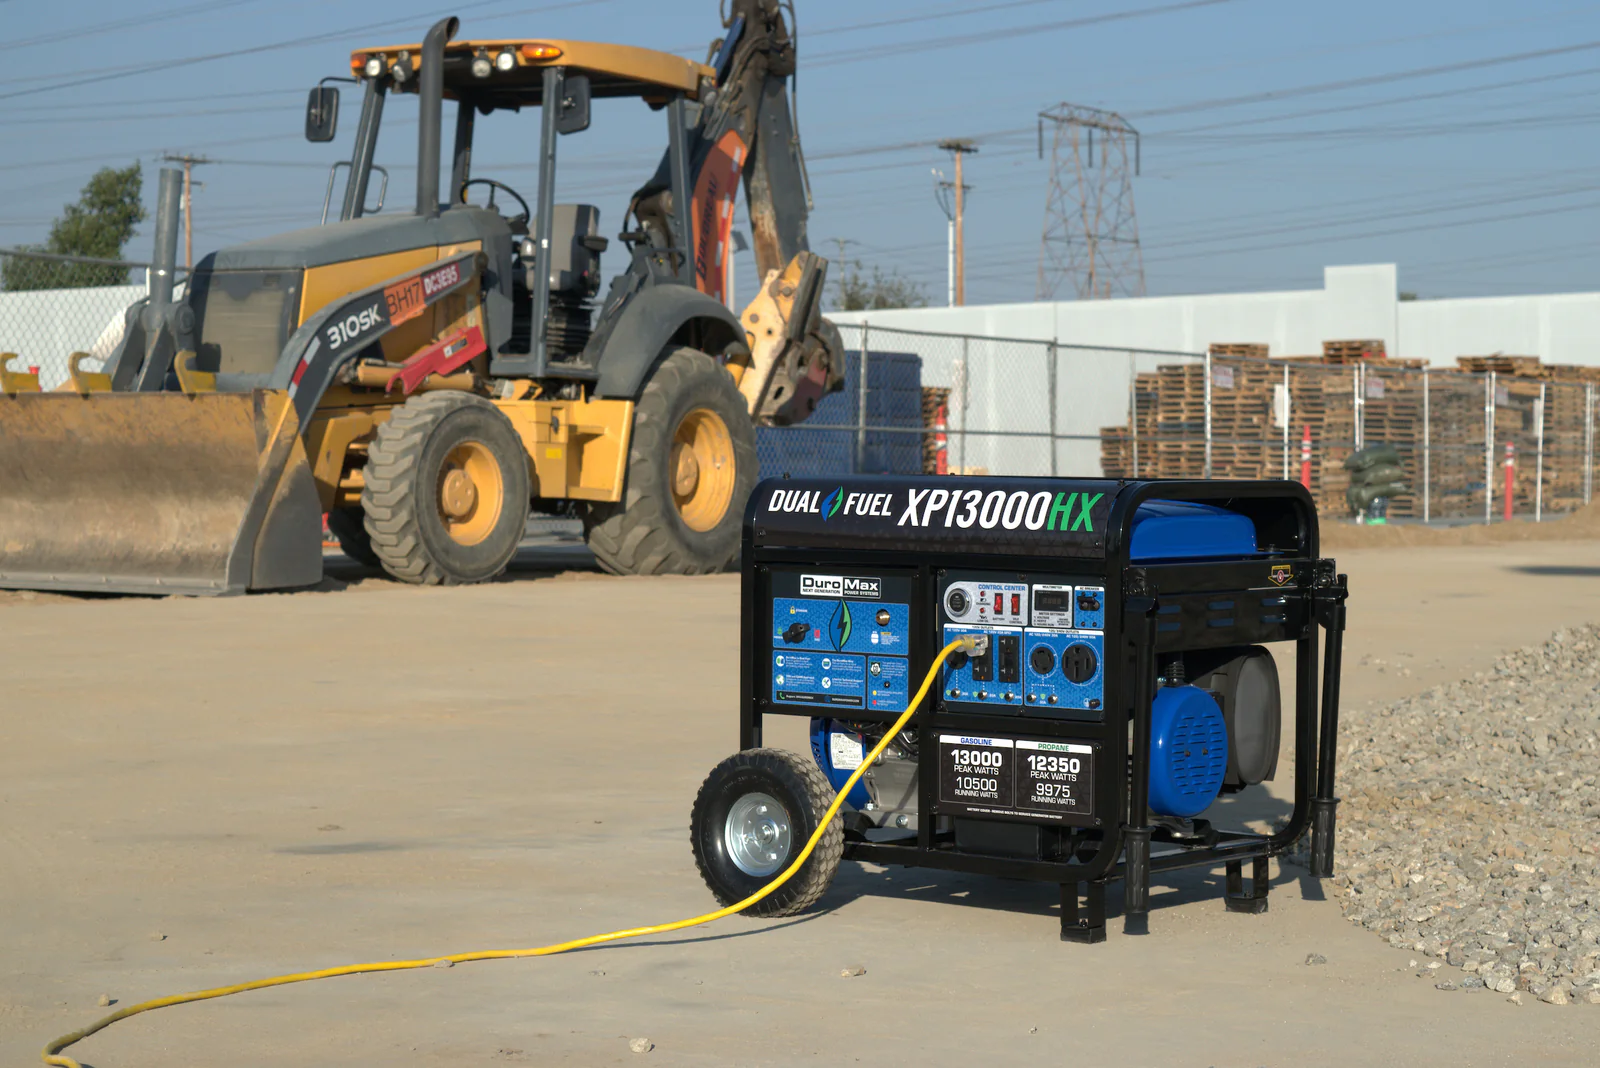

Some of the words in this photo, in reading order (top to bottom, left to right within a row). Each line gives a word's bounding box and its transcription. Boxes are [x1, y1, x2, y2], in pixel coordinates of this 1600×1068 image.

[423, 266, 458, 294] DC3E95
[326, 303, 382, 350] 310SK
[768, 490, 821, 512] DUAL
[843, 492, 893, 516] FUEL
[897, 488, 1104, 532] XP13000HX
[960, 738, 992, 746] GASOLINE
[1038, 743, 1069, 751] PROPANE
[951, 749, 1002, 767] 13000
[1027, 755, 1080, 773] 12350
[954, 765, 972, 773] PEAK
[974, 766, 999, 775] WATTS
[1031, 771, 1049, 779] PEAK
[1051, 773, 1077, 782] WATTS
[956, 777, 997, 791] 10500
[1036, 783, 1070, 798] 9975
[955, 789, 979, 797] RUNNING
[1031, 796, 1056, 804] RUNNING
